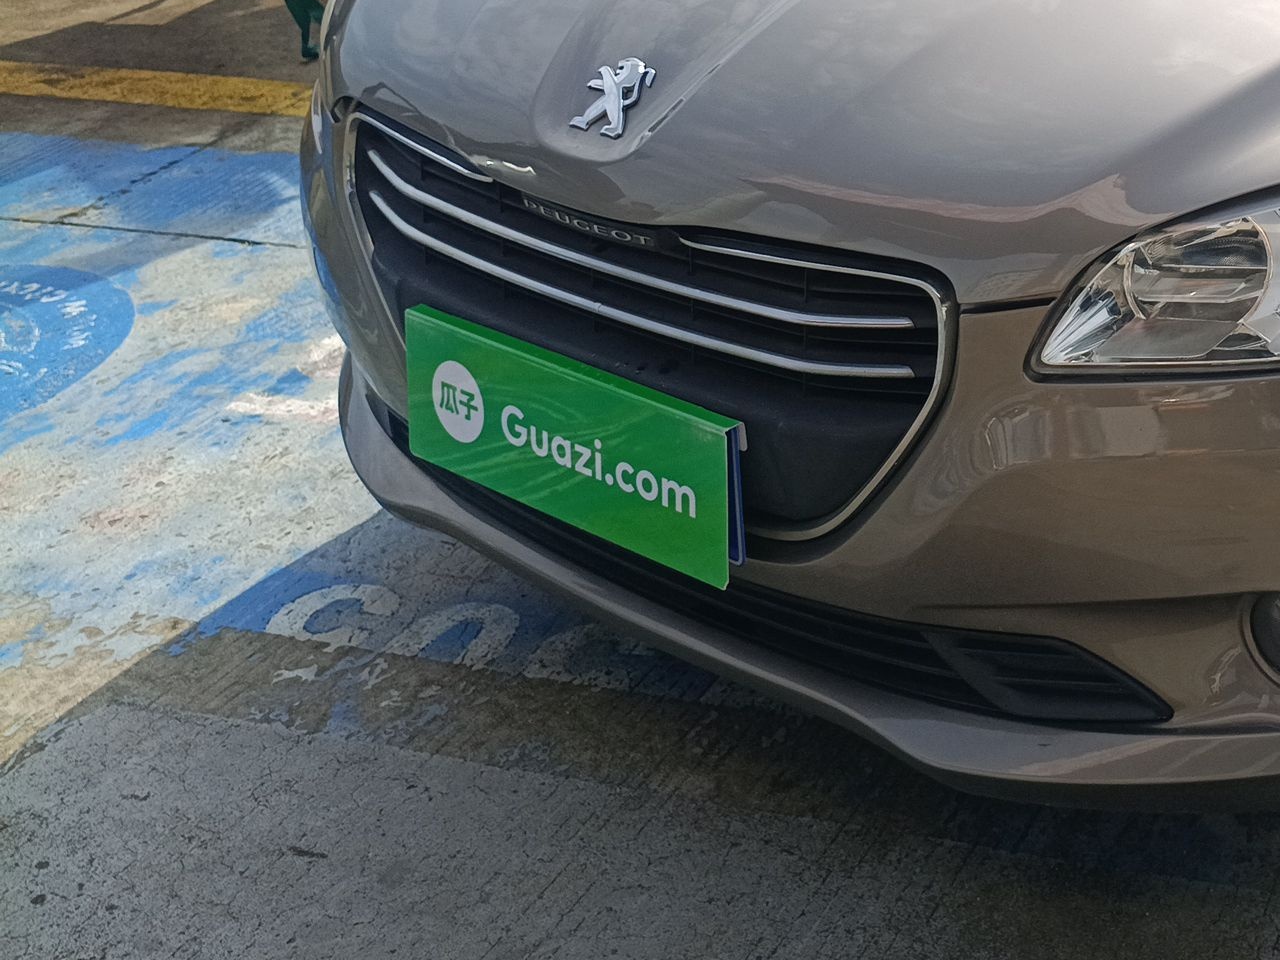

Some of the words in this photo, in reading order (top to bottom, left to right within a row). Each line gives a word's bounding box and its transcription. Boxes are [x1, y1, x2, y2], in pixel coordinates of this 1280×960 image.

[523, 198, 651, 245] PEUGEOT
[439, 381, 479, 421] 瓜子
[501, 405, 696, 518] Guazi.com
